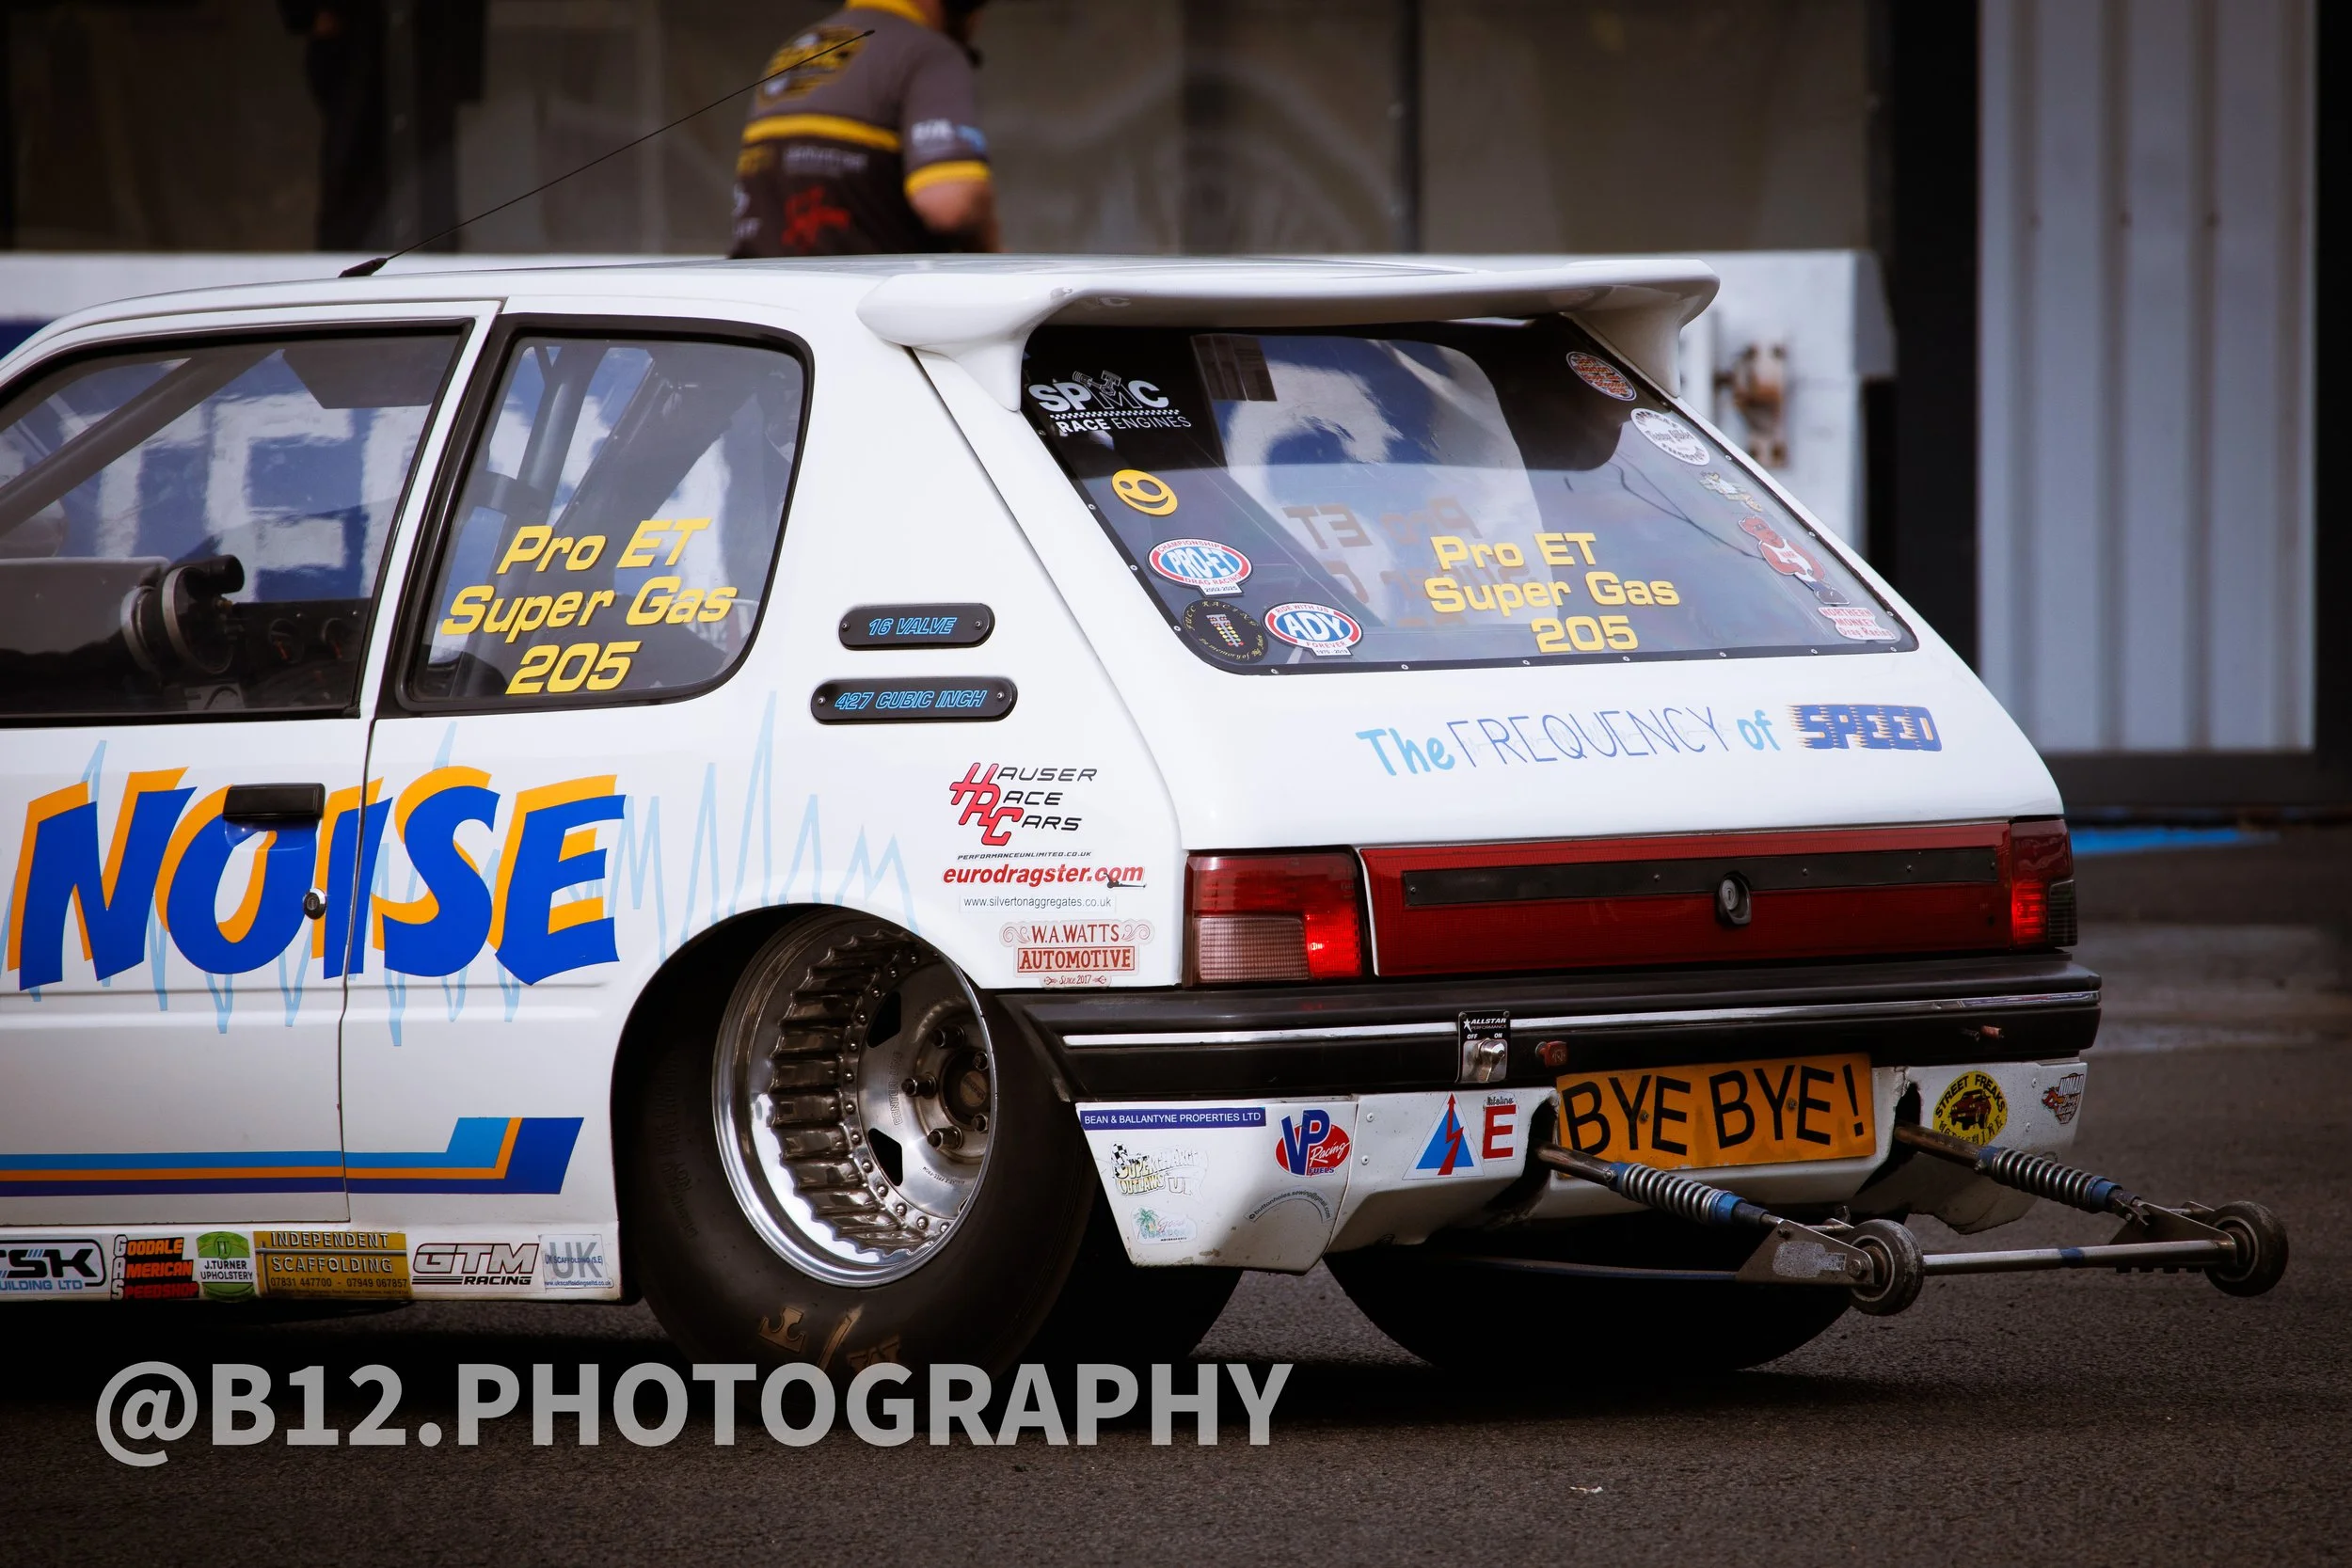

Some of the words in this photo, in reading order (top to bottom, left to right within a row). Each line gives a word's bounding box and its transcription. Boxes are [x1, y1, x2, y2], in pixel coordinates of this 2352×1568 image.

[1056, 419, 1111, 434] RACE
[1110, 416, 1191, 429] ENGINES
[497, 525, 606, 574] Pro
[617, 518, 712, 568] ET
[1430, 535, 1525, 570] Pro
[1534, 532, 1597, 565] ET
[1167, 547, 1236, 578] PRO-ET
[1213, 575, 1242, 585] RACING
[1424, 576, 1571, 616] Super
[1585, 571, 1680, 605] Gas
[441, 585, 617, 642] Super
[626, 577, 739, 626] Gas
[1275, 605, 1293, 613] RIDE
[868, 617, 894, 635] 16
[896, 616, 957, 635] VALVE
[1283, 611, 1344, 641] ADY
[1531, 615, 1638, 653] 205
[505, 641, 641, 695] 205
[834, 692, 875, 710] 427
[875, 690, 934, 709] CUBIC
[935, 689, 987, 708] INCH
[1356, 727, 1455, 777] The
[1447, 705, 1731, 768] FREQUENCY
[1737, 709, 1782, 752] of
[1786, 703, 1944, 752] SPEED
[8, 766, 628, 991] NOISE
[943, 863, 1145, 888] eurodragster.com
[963, 896, 1112, 910] www.silvertonaggregates.co.uk
[1019, 948, 1131, 970] AUTOMOTIVE
[1058, 974, 1076, 985] Since
[1076, 974, 1092, 985] 2017
[1935, 1075, 1969, 1118] STREET
[1974, 1074, 2006, 1113] FREAKS
[1084, 1116, 1108, 1125] BEAN
[1110, 1116, 1118, 1124] &
[1119, 1114, 1178, 1124] BALLANTYNE
[1179, 1114, 1240, 1123] PROPERTIES
[1242, 1112, 1262, 1122] LTD
[1562, 1074, 1691, 1158] BYE
[1709, 1063, 1866, 1150] BYE!
[1280, 1109, 1330, 1176] VP
[1483, 1104, 1517, 1159] E
[1309, 1141, 1352, 1167] Racing
[113, 1234, 183, 1257] GOODALE
[271, 1231, 388, 1248] INDEPENDENT
[0, 1248, 98, 1278] SK
[112, 1258, 194, 1279] AMERICAN
[204, 1259, 246, 1270] J.TURNER
[271, 1257, 392, 1273] SCAFFOLDING
[412, 1243, 540, 1275] GTM
[549, 1242, 602, 1279] UK
[58, 1279, 83, 1290] LTD
[200, 1271, 253, 1280] UPHOLSTERY
[270, 1277, 296, 1287] 07831
[300, 1277, 332, 1287] 447700
[346, 1278, 373, 1288] 07949
[376, 1278, 407, 1288] 067857
[463, 1275, 532, 1286] RACING
[111, 1278, 199, 1300] SPEEDSHOP
